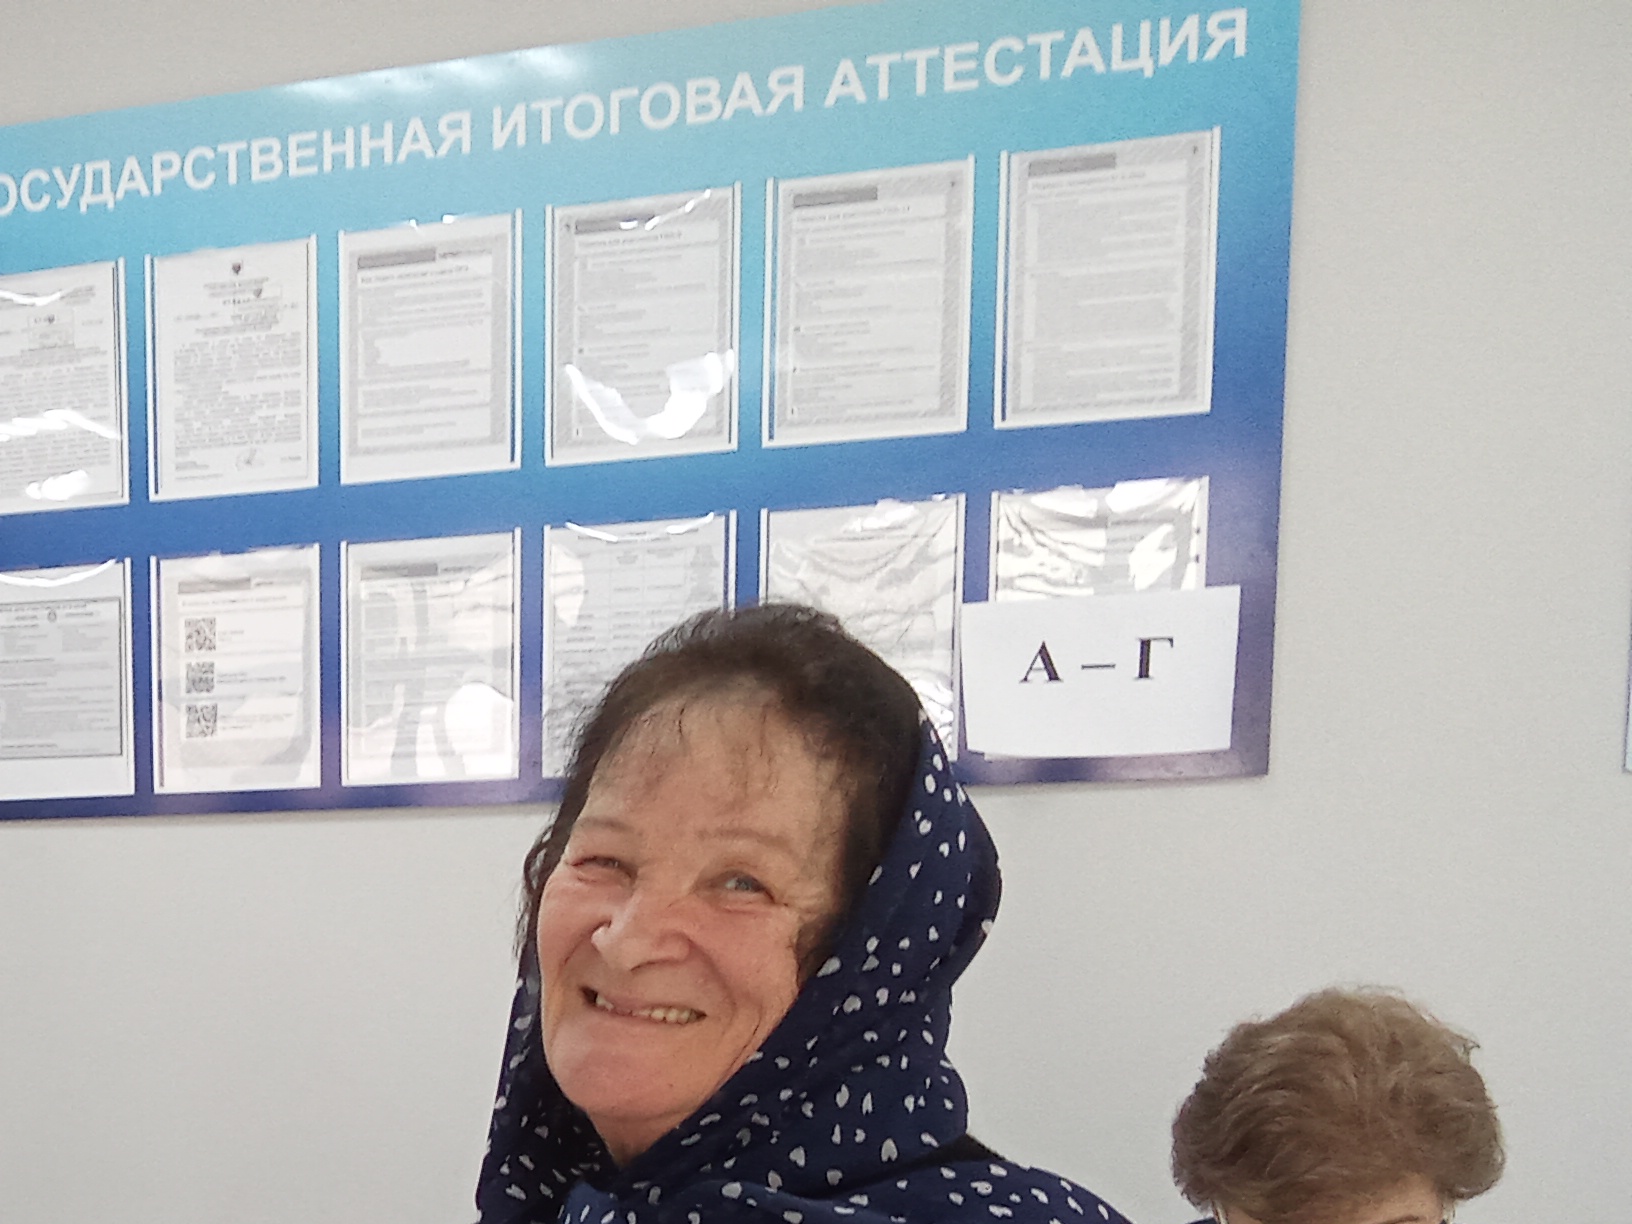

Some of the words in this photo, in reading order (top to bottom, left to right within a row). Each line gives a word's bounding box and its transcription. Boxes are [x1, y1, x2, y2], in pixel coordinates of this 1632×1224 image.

[491, 64, 805, 150] ИТОГОВАЯ
[824, 8, 1249, 107] АТТЕСТАЦИЯ
[1019, 640, 1064, 684] А
[1133, 636, 1174, 682] Г
